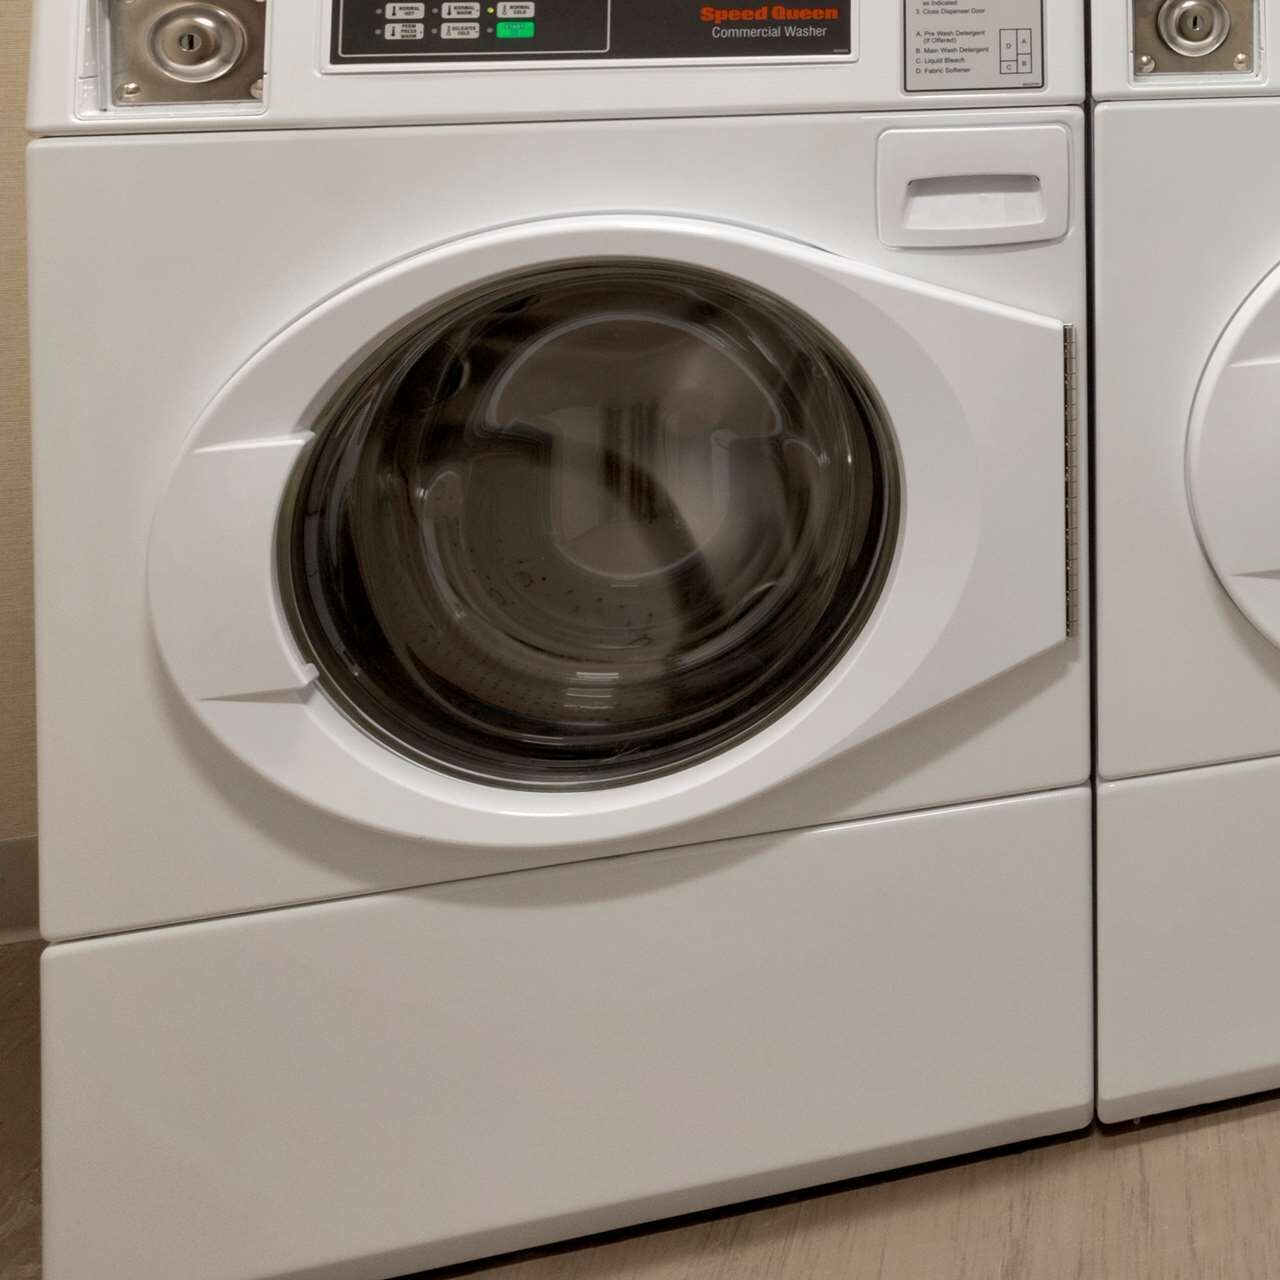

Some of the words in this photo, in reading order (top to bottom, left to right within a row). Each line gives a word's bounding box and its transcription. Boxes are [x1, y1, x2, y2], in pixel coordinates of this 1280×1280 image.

[701, 6, 768, 24] Speed
[771, 6, 838, 20] Queen
[712, 26, 781, 38] Commercial
[784, 25, 827, 37] Washer
